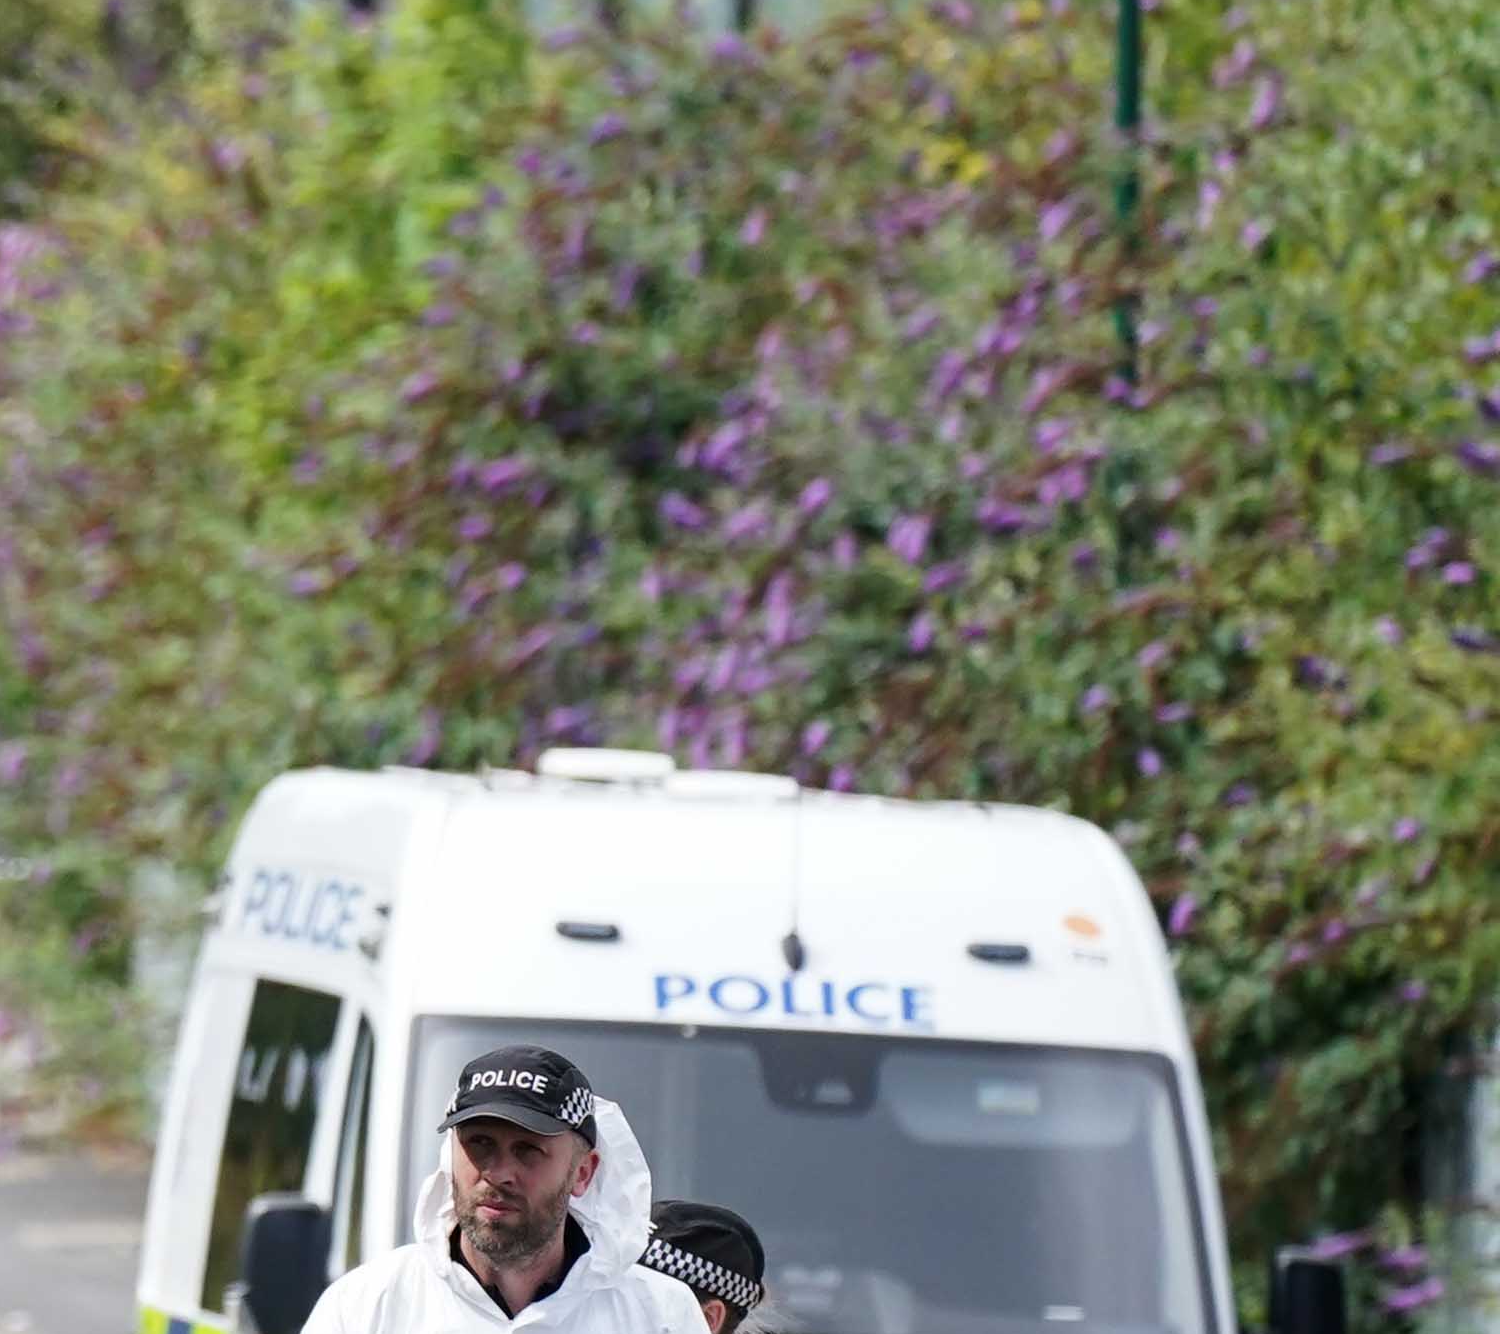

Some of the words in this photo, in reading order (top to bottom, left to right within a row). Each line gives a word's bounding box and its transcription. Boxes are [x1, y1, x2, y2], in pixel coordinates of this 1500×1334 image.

[242, 868, 366, 951] POLICE
[654, 974, 936, 1029] POLICE
[469, 1069, 549, 1094] POLICE
